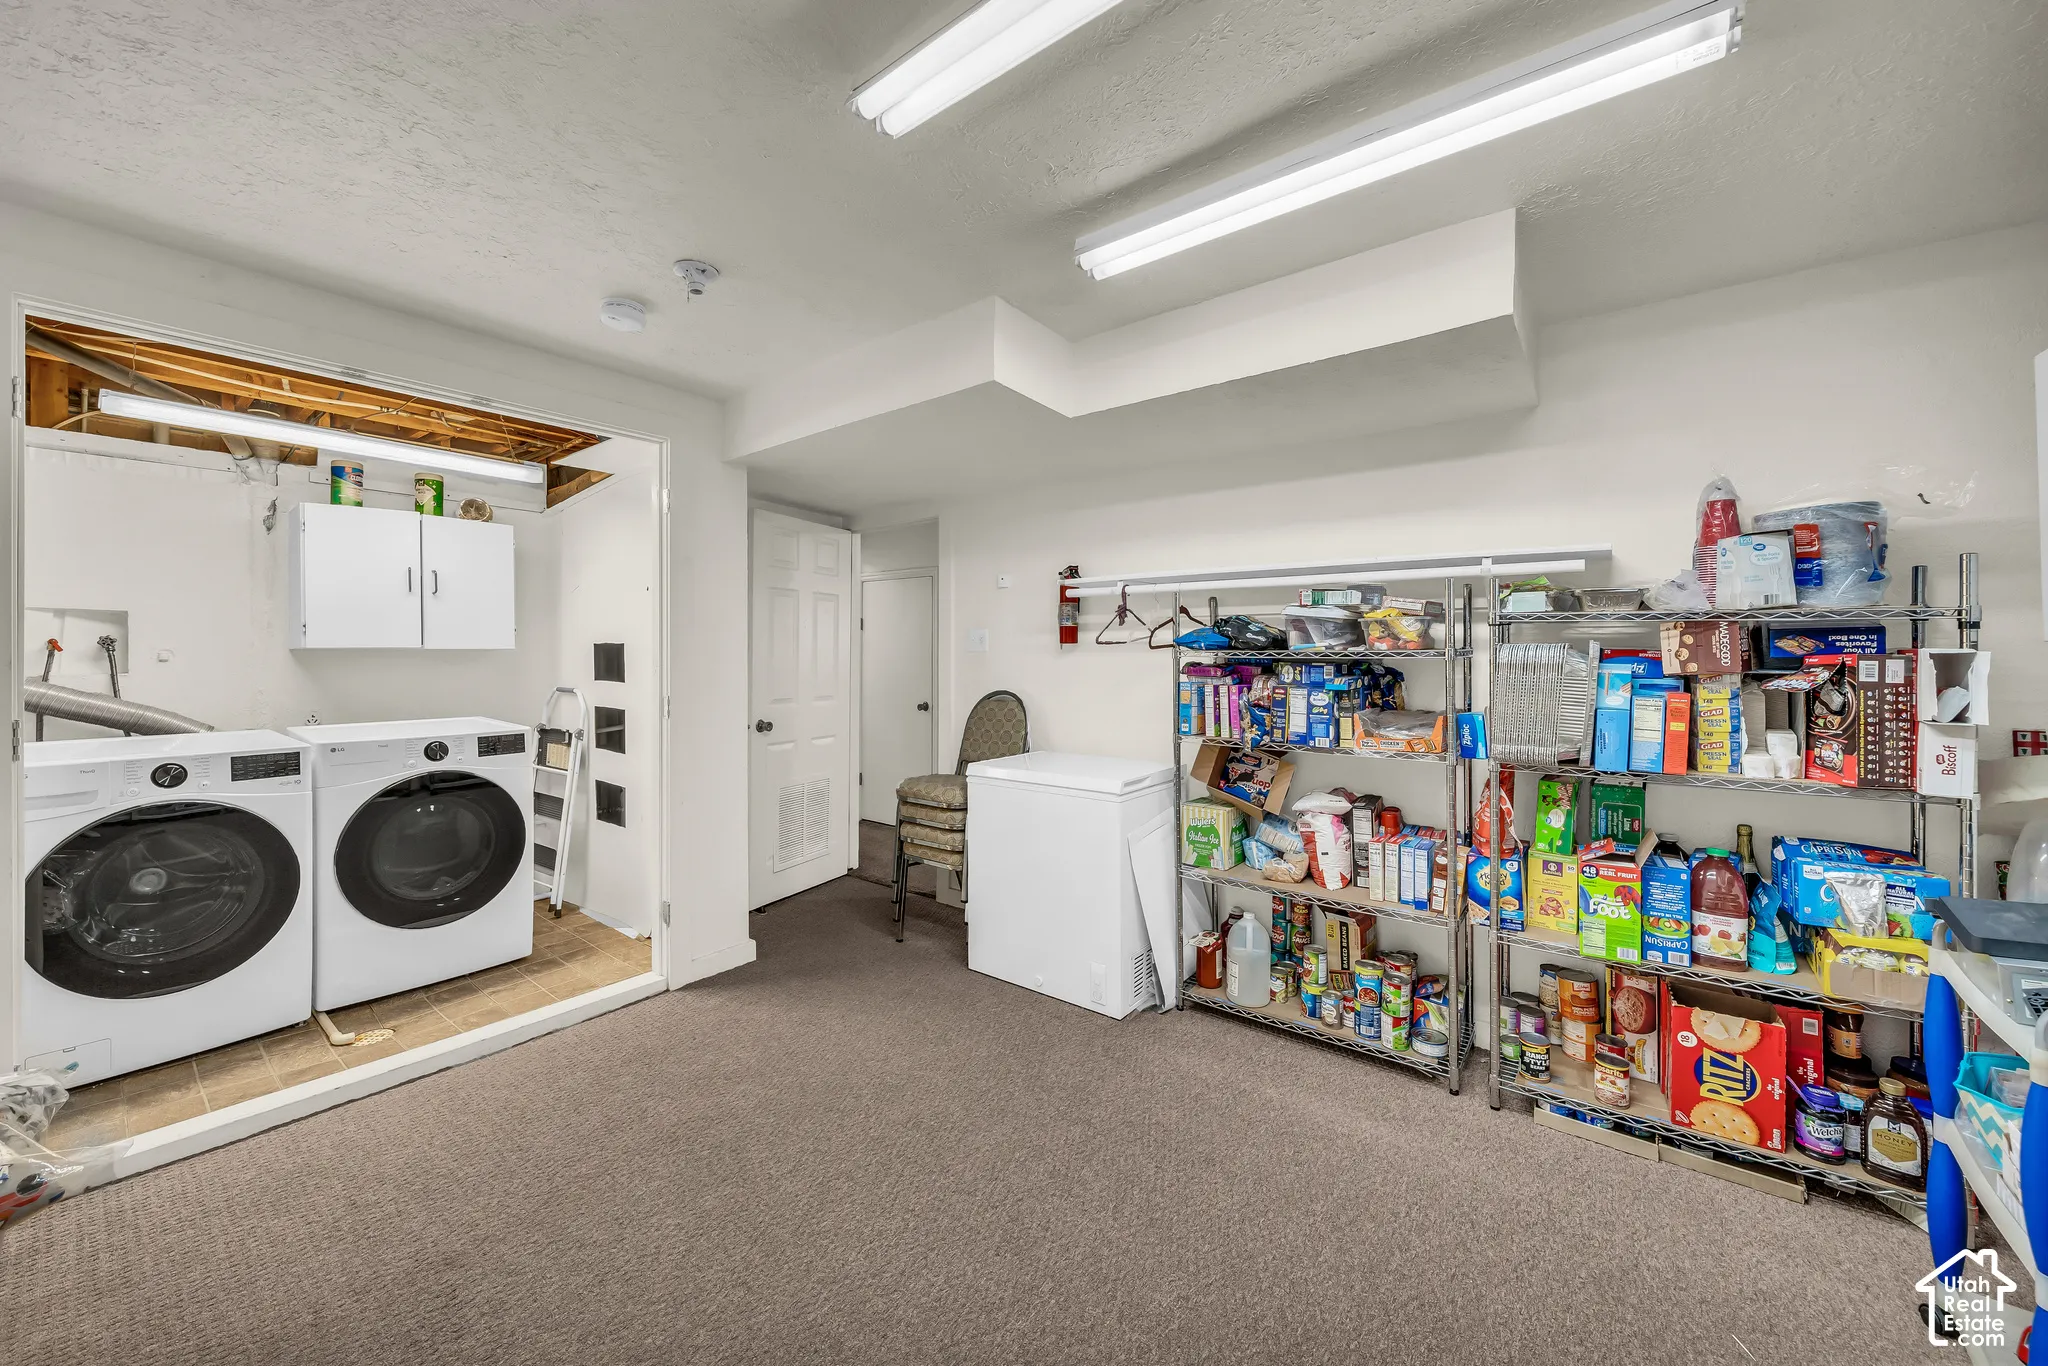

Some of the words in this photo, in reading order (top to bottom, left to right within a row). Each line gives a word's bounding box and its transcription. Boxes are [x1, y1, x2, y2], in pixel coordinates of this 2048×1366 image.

[1720, 622, 1730, 666] MADEGOOD
[1632, 662, 1645, 674] Zip
[1700, 675, 1722, 684] GLAD
[1700, 708, 1722, 717] GLAD
[1464, 724, 1472, 745] Ziploc
[1942, 745, 1957, 775] Biscoff
[1190, 818, 1216, 828] Wyler's
[1189, 830, 1208, 842] Italian
[1210, 834, 1220, 844] Ice
[1480, 871, 1508, 880] Hoey
[1681, 1034, 1690, 1044] 18
[1524, 1057, 1549, 1066] STYLE
[1526, 1051, 1549, 1059] RANCH
[1700, 1047, 1747, 1106] RITZ
[1772, 1078, 1782, 1100] original
[1811, 1122, 1843, 1137] Welch's
[1876, 1132, 1913, 1147] HONEY
